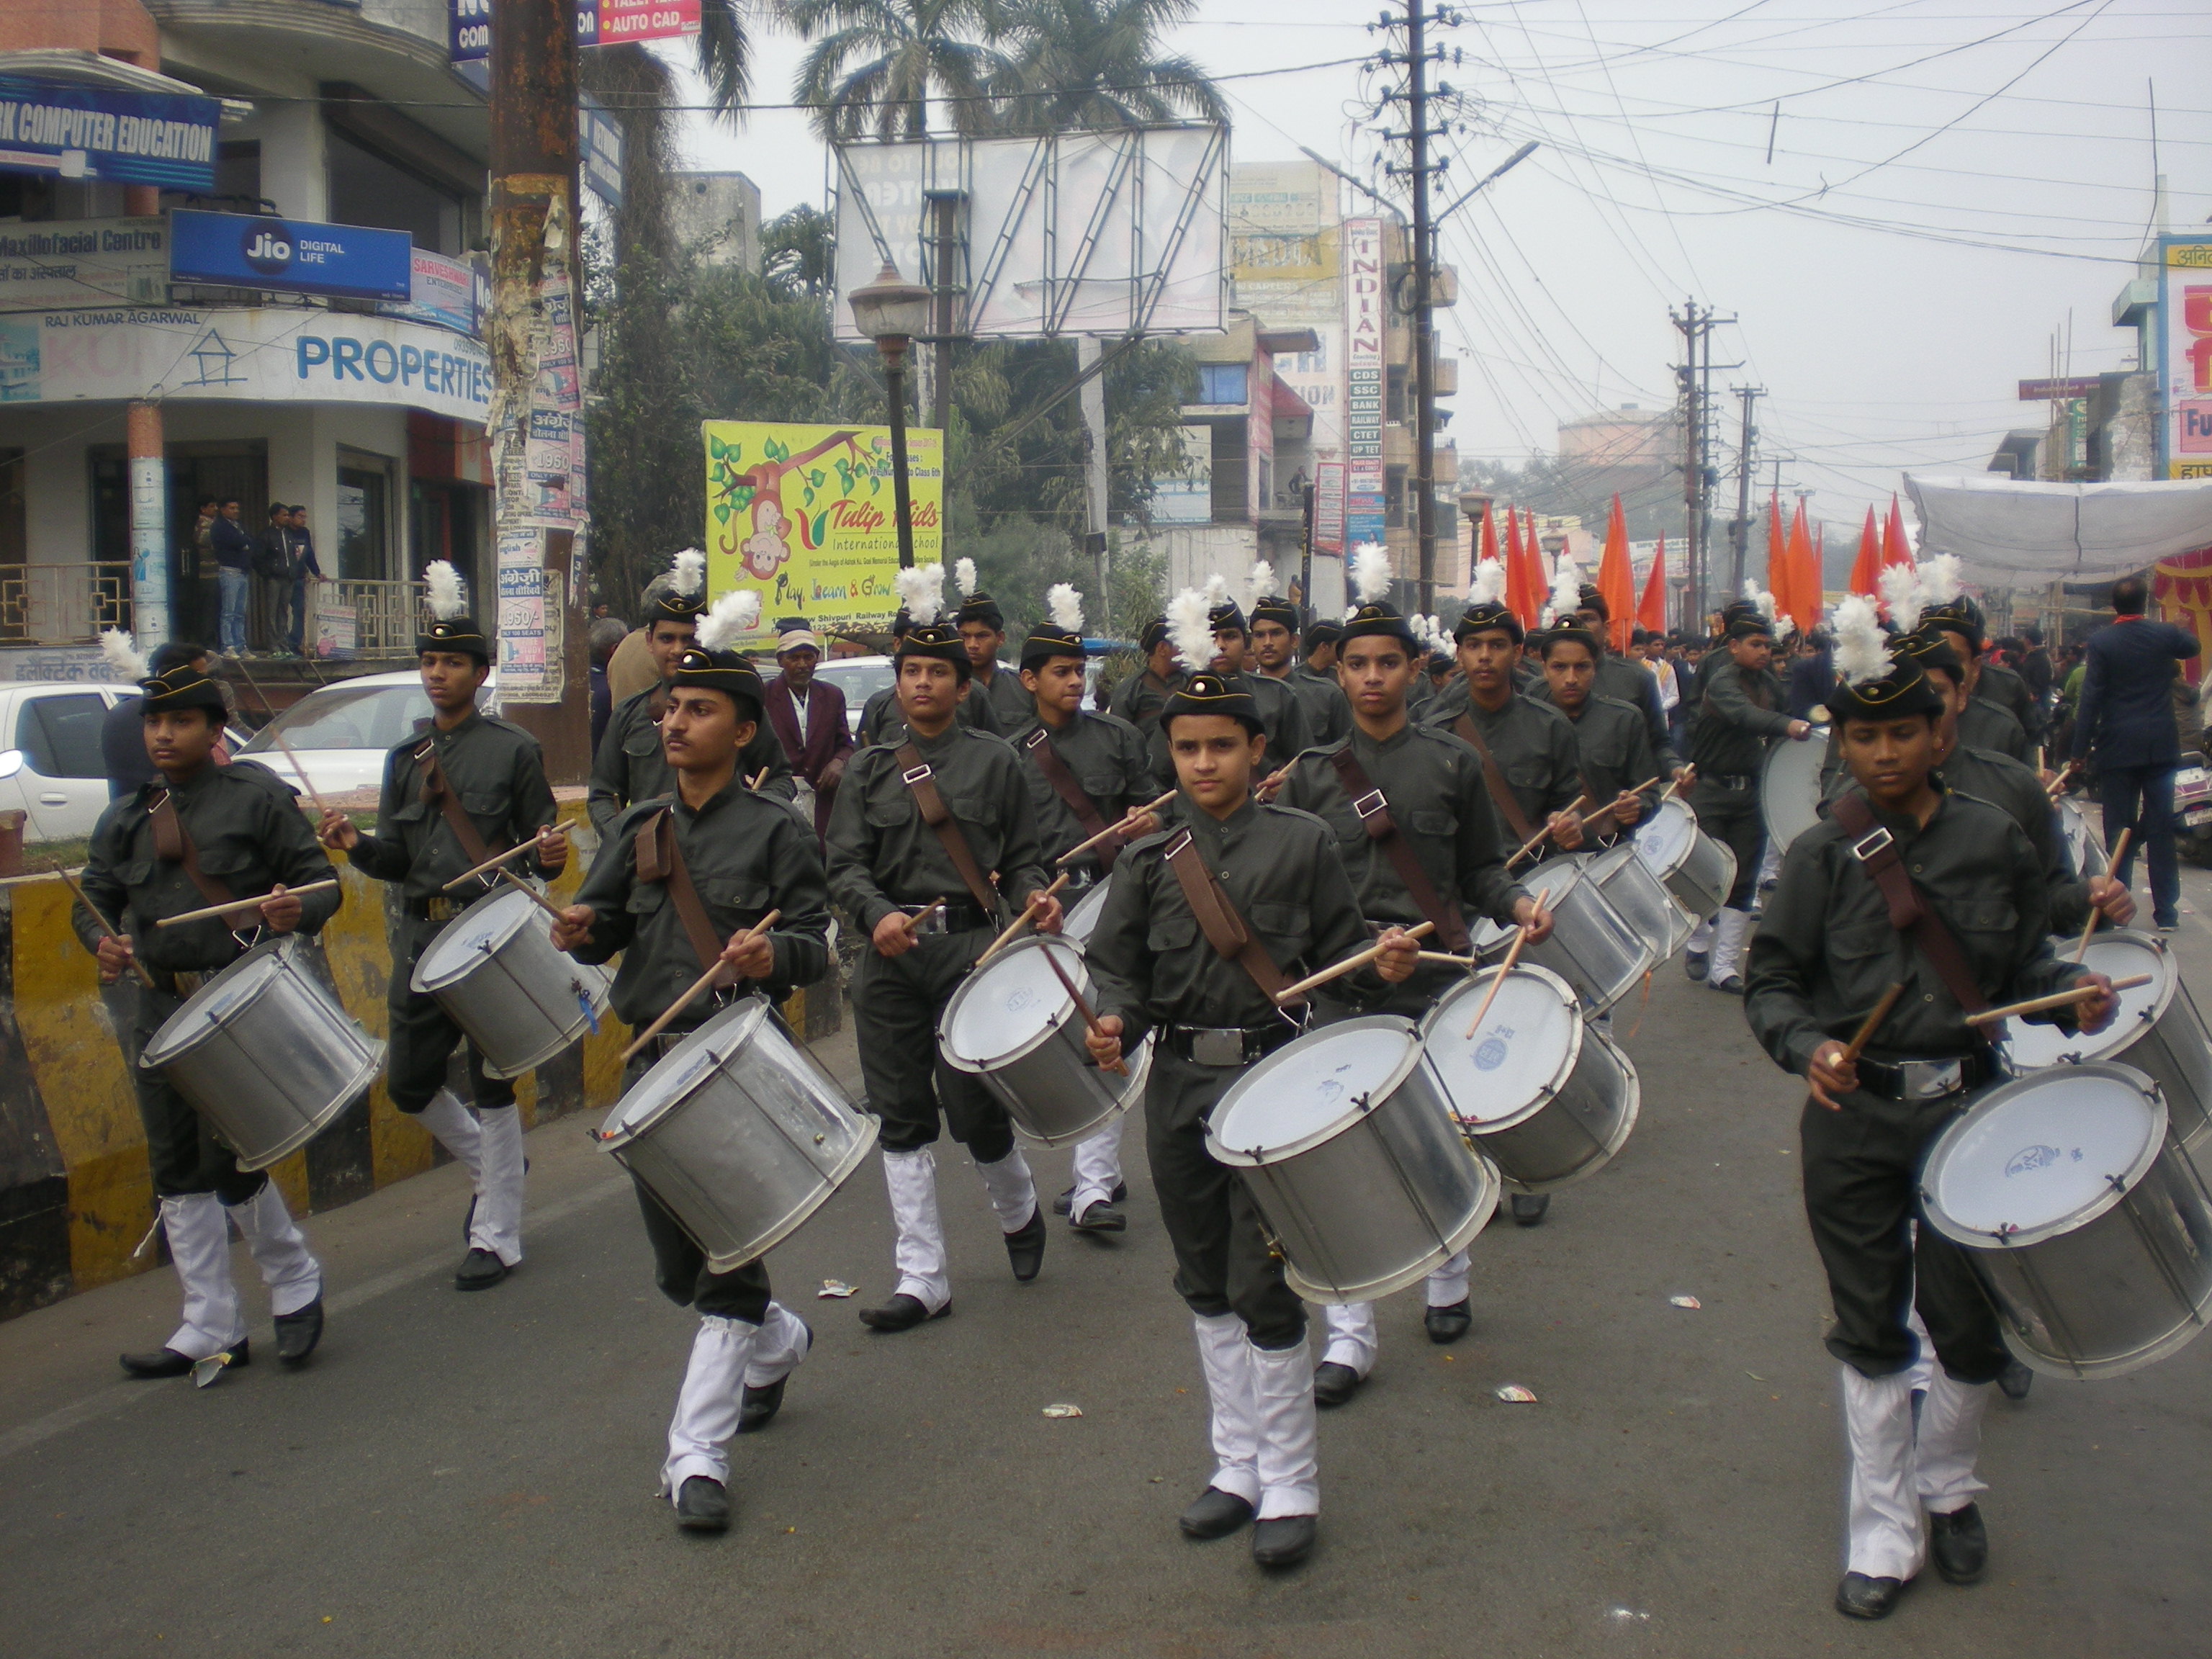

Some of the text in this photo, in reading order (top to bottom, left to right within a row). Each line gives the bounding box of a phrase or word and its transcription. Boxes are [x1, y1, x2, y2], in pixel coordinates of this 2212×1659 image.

[613, 14, 648, 32] AUTO
[652, 12, 680, 28] CAD
[19, 103, 115, 151] COMPUTER
[117, 114, 212, 162] EDUCATION
[102, 229, 161, 251] Centre
[247, 232, 345, 260] Jio DIGITAL
[300, 252, 325, 264] LIFE
[1352, 239, 1378, 353] INDIAN
[45, 311, 201, 328] RAJ KUMAR AGARWAL
[297, 336, 494, 405] PROPERTIES
[1353, 371, 1378, 379] CDS
[1353, 386, 1378, 395] SSC
[1352, 415, 1380, 424] RAILWAY
[1353, 431, 1378, 439] CTET
[830, 499, 886, 534] Tulip
[833, 535, 939, 551] Internationa chool
[775, 571, 891, 610] Play, Learn & Grow
[819, 614, 851, 624] Shivpuri
[856, 612, 886, 621] Railway
